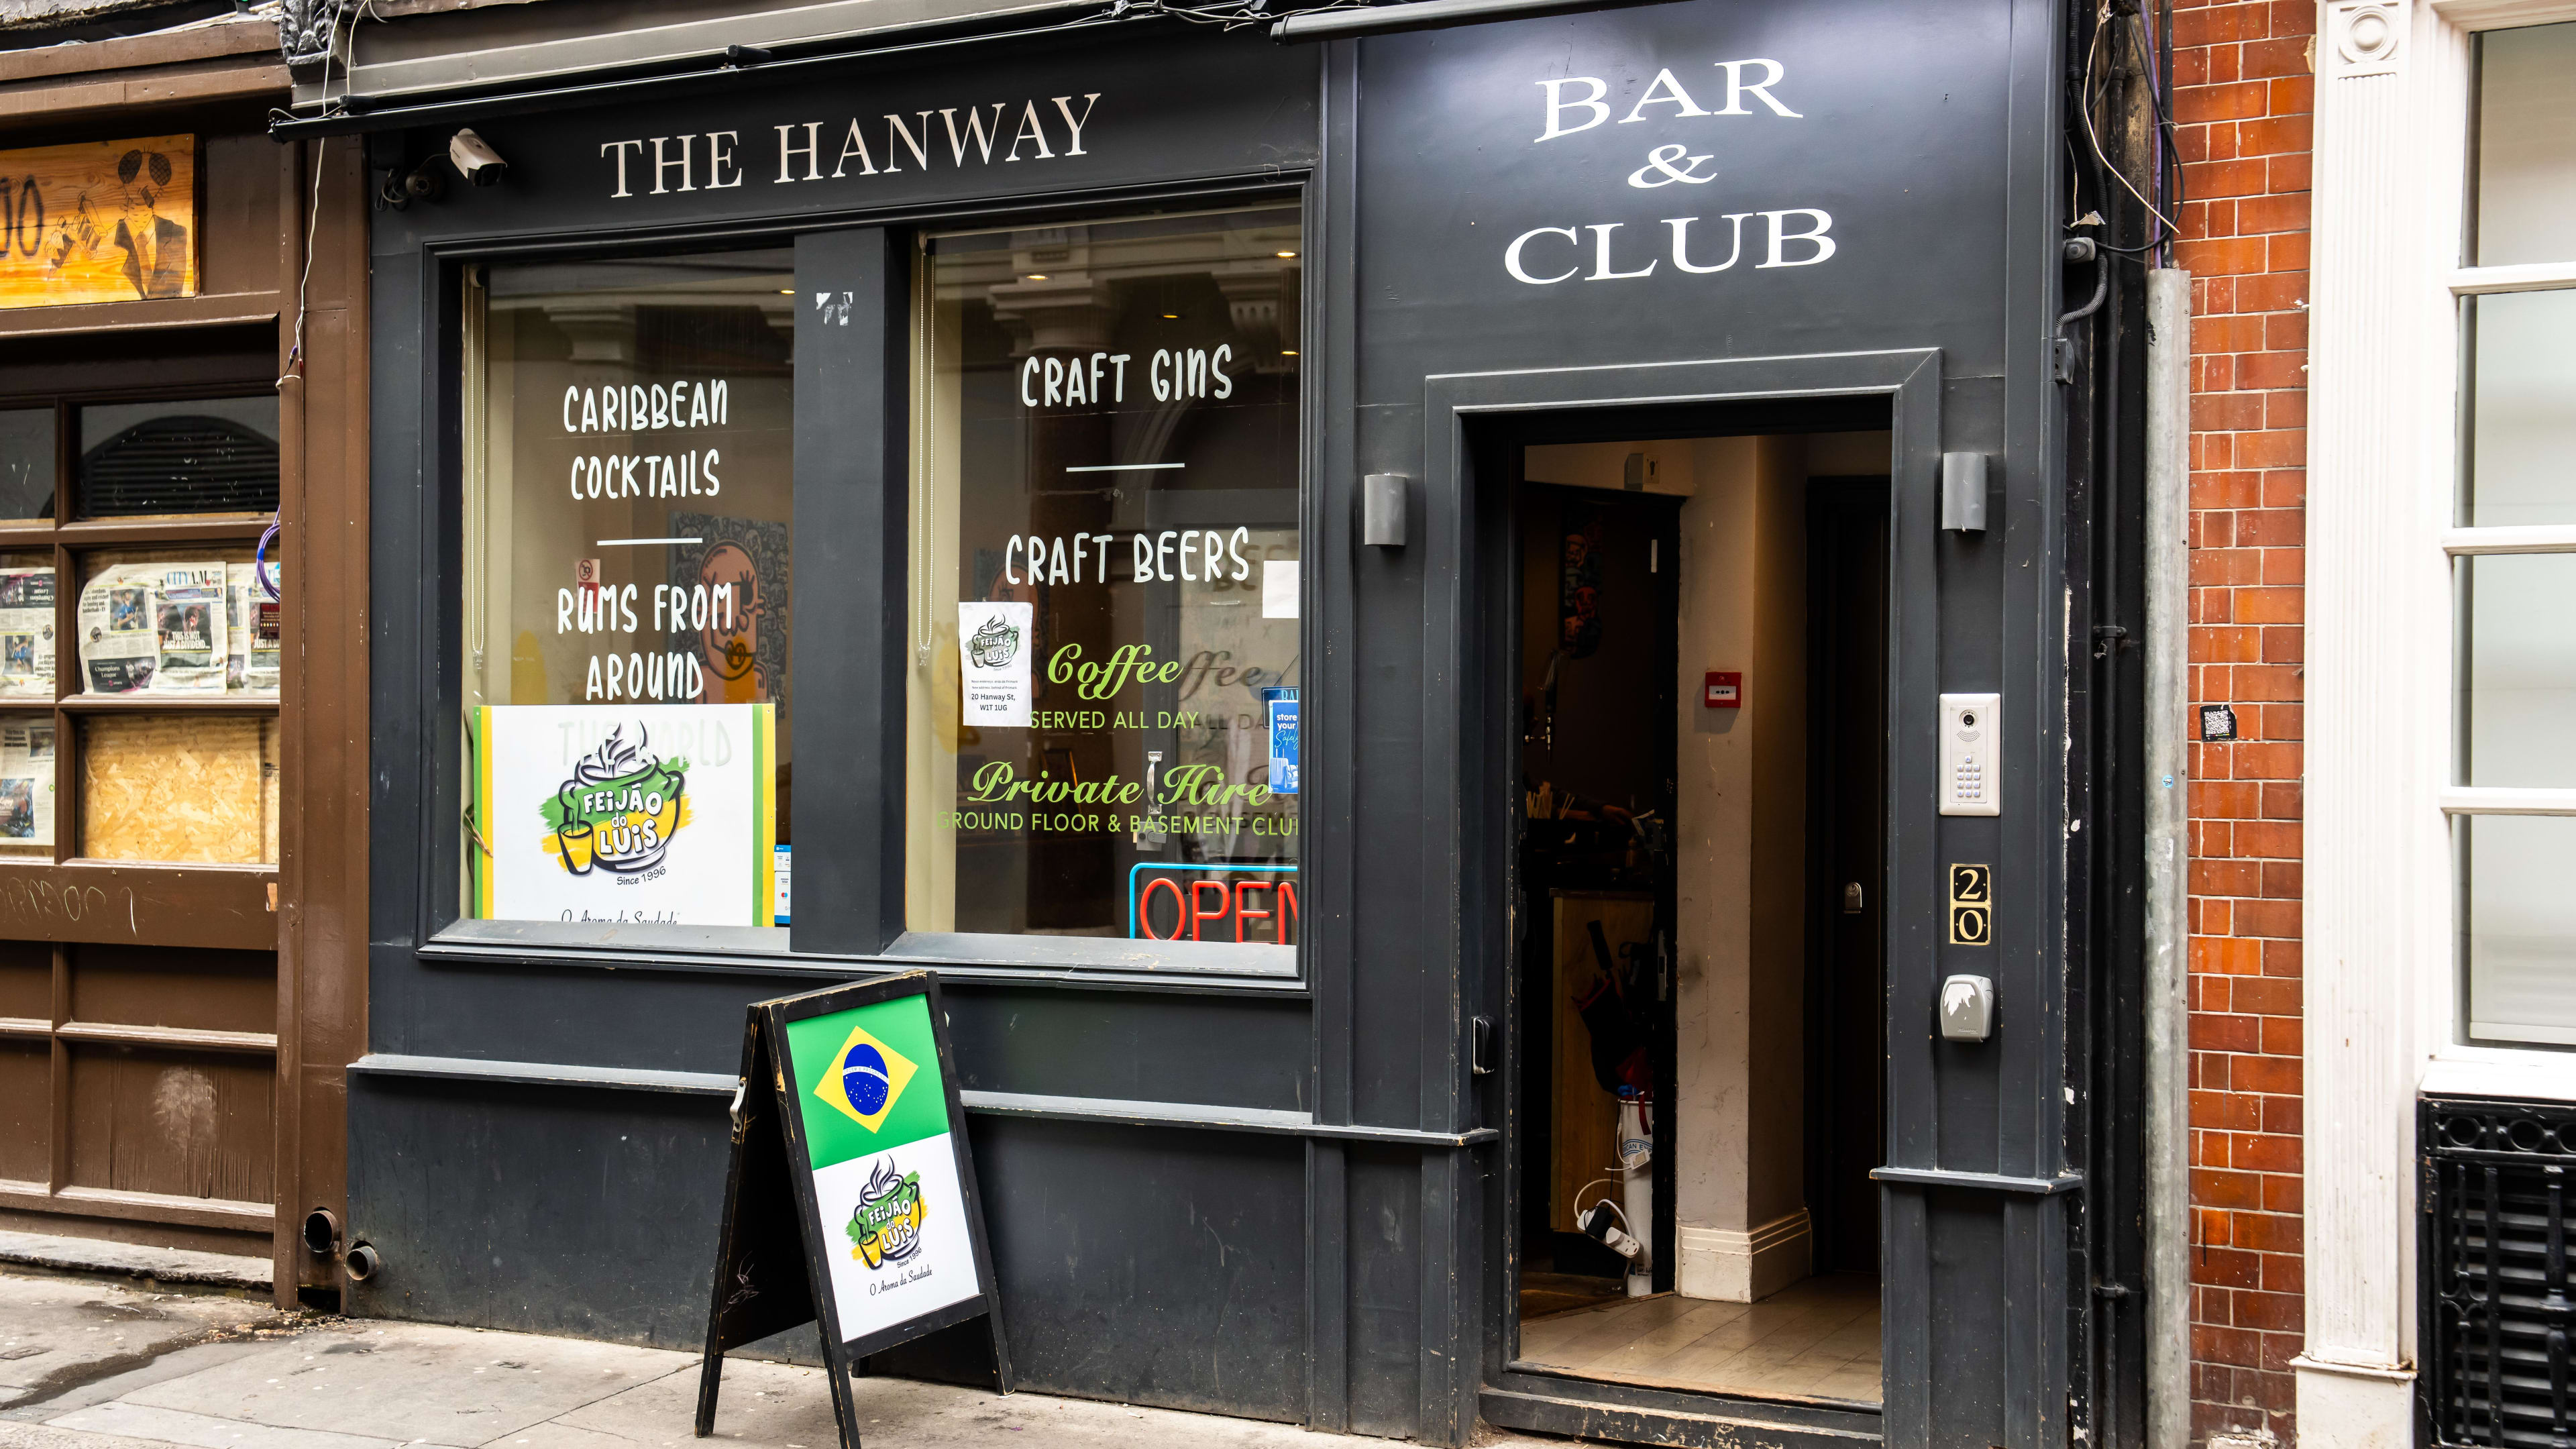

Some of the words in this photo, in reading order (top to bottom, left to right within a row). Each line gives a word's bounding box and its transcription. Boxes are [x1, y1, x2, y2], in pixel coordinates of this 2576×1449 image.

[1534, 58, 1803, 143] BAR
[601, 130, 742, 198] THE
[773, 93, 1101, 183] HANWAY
[1627, 144, 1718, 189] &
[1505, 208, 1836, 284] CLUB
[1021, 352, 1130, 407] CRAFT
[1151, 343, 1233, 402] GINS
[563, 379, 728, 433] CARIBBEAN
[570, 449, 720, 500] COCKTAILS
[1006, 532, 1114, 586] CRAFT
[1134, 526, 1249, 583] BEERS
[557, 584, 637, 634] RUMS
[654, 582, 733, 633] FROM
[172, 631, 183, 640] THIS
[190, 631, 200, 639] NOT
[586, 651, 704, 701] AROUND
[1047, 643, 1183, 700] Coffee
[981, 694, 1006, 702] Hanway
[1030, 711, 1106, 729] SERVED
[1113, 711, 1149, 729] ALL
[1158, 711, 1199, 729] DAY
[1277, 713, 1297, 721] store
[1277, 722, 1295, 731] your
[967, 761, 1144, 804] Private
[1157, 763, 1275, 806] Hire
[611, 812, 627, 828] do
[937, 811, 1024, 830] GROUND
[1032, 812, 1099, 832] FLOOR
[1108, 814, 1121, 833] &
[1130, 814, 1244, 835] BASEMENT
[1252, 816, 1298, 836] CLU
[617, 877, 639, 885] Since
[641, 865, 666, 882] 1996
[886, 1218, 895, 1230] do
[910, 1246, 922, 1260] 1996
[869, 1283, 876, 1295] O
[878, 1279, 899, 1294] Aroma
[900, 1273, 908, 1286] da
[908, 1264, 932, 1283] Saudade
